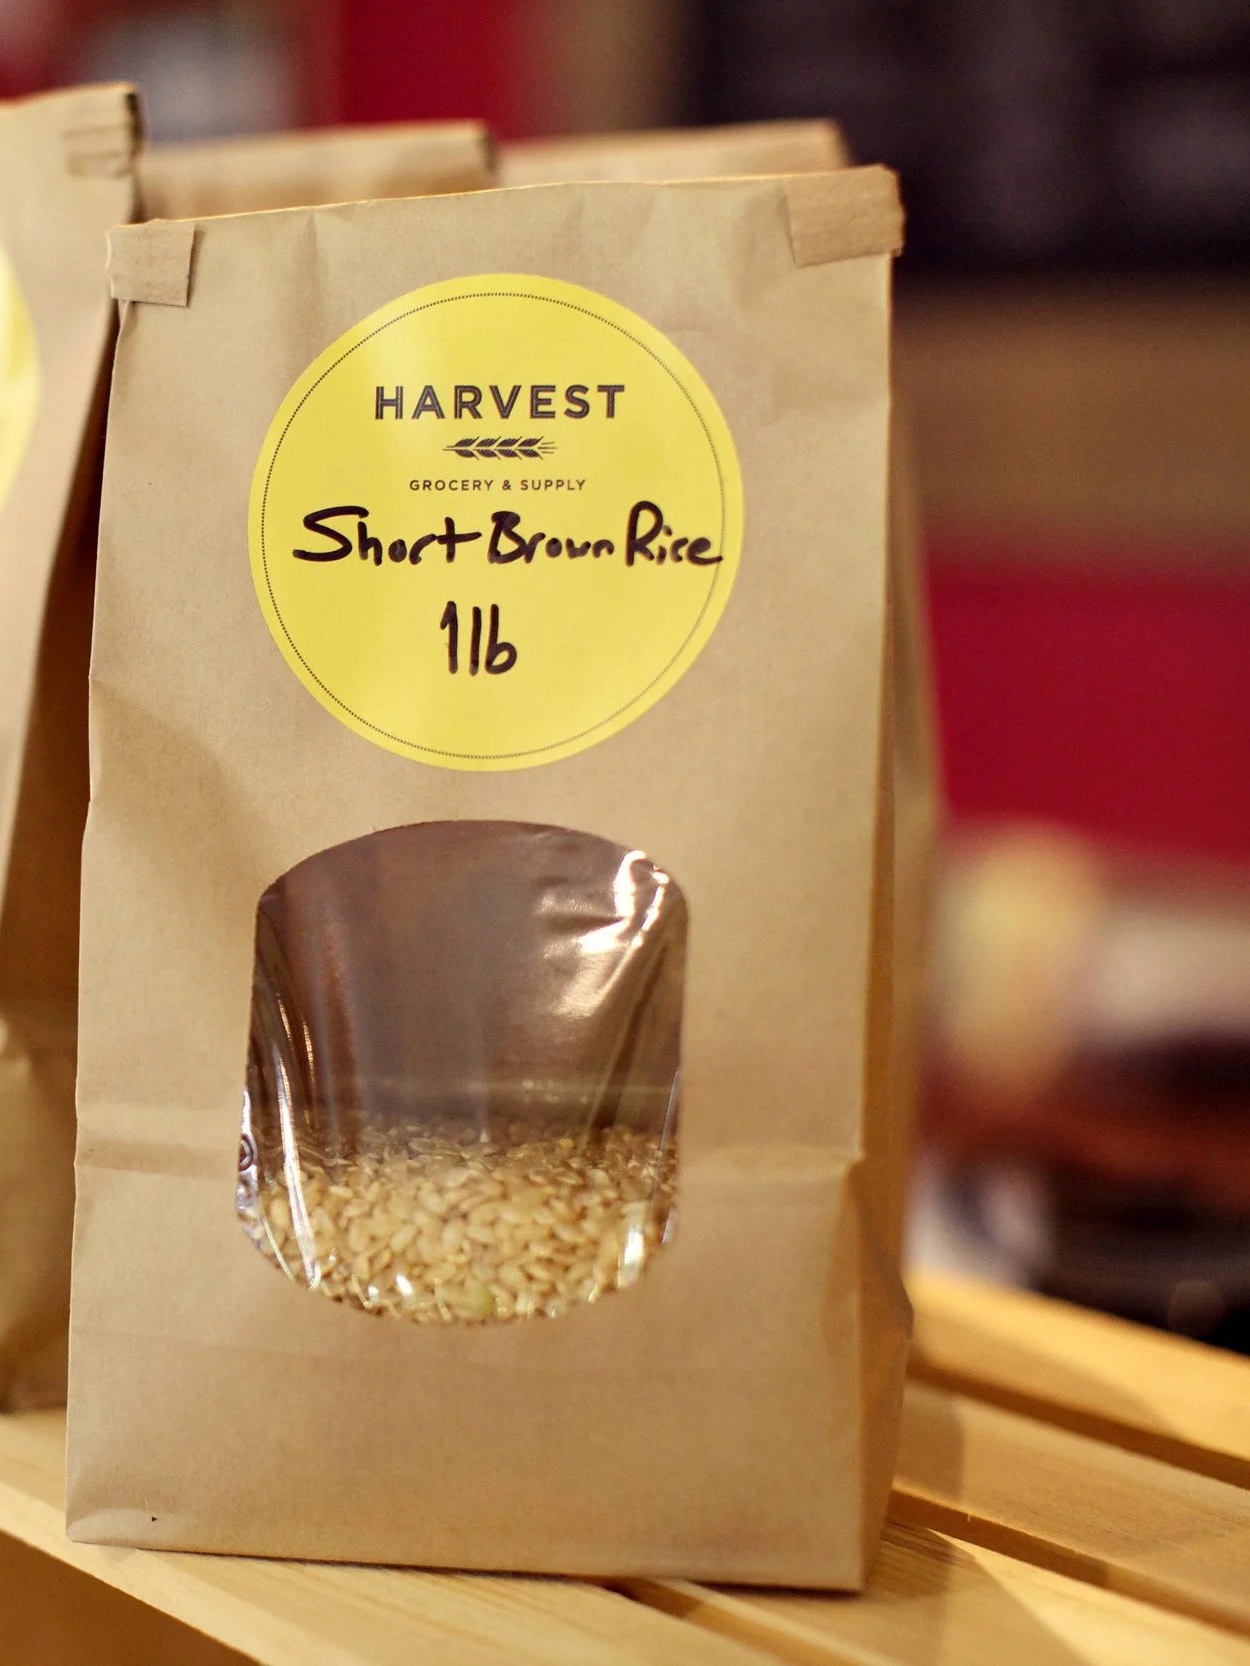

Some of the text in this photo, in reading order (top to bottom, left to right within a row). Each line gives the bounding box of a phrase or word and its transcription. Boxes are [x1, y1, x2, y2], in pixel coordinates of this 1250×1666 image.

[374, 384, 626, 421] HARVEST
[409, 479, 587, 492] GROCERY & SUPPLY
[291, 500, 724, 568] Short Brown Rice
